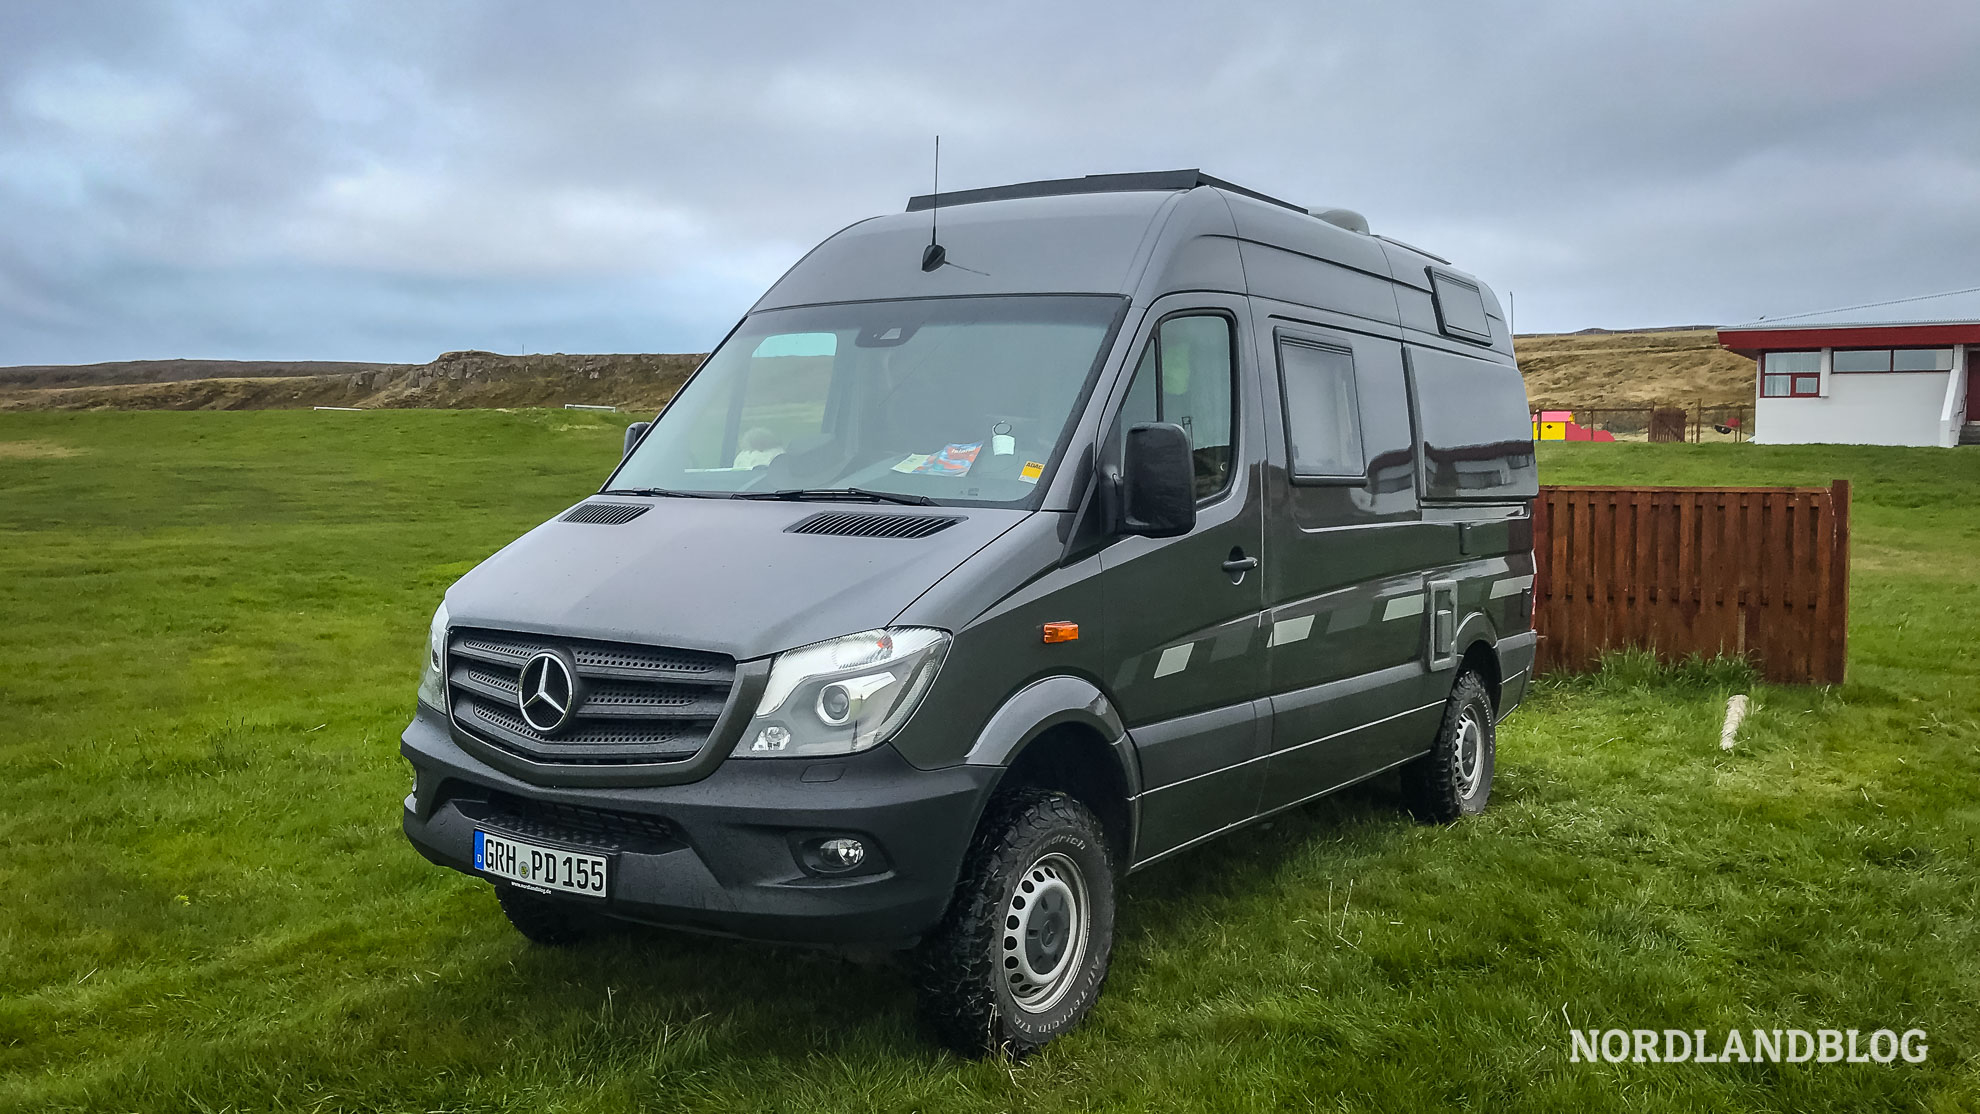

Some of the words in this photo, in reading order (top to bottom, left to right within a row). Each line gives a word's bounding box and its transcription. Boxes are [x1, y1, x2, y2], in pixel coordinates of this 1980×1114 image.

[1026, 462, 1043, 470] ADAC
[477, 854, 482, 863] D
[485, 838, 516, 876] GRH
[531, 850, 557, 884] PD
[562, 856, 604, 892] 155
